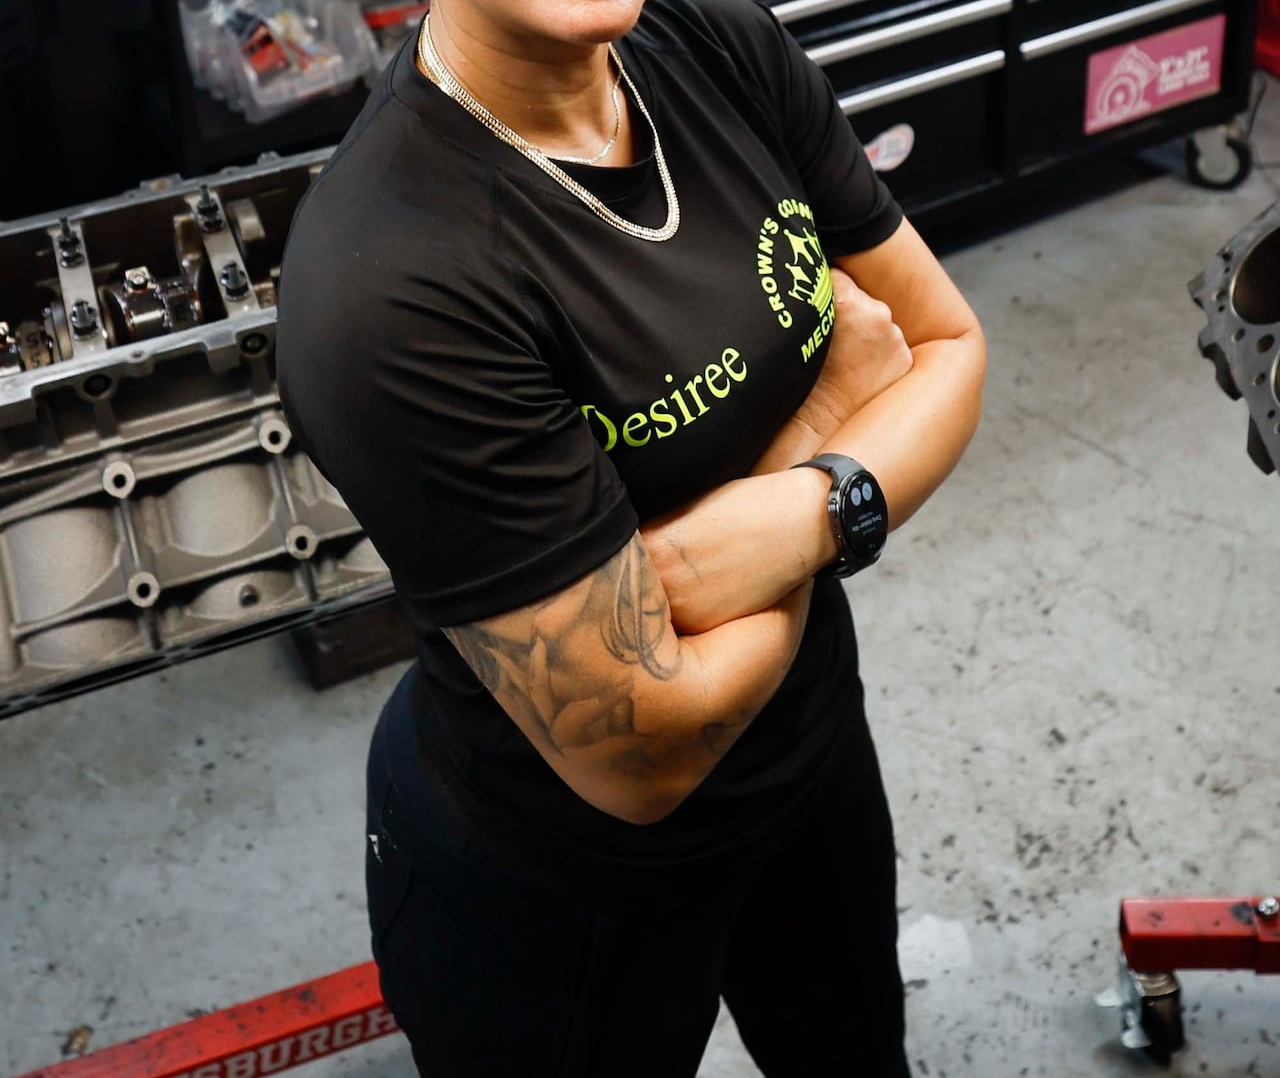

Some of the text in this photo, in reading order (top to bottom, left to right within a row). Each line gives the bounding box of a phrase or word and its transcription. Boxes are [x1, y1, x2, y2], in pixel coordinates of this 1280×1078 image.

[757, 217, 793, 329] CROWN'S
[801, 308, 835, 363] MECH
[581, 347, 748, 452] Desiree
